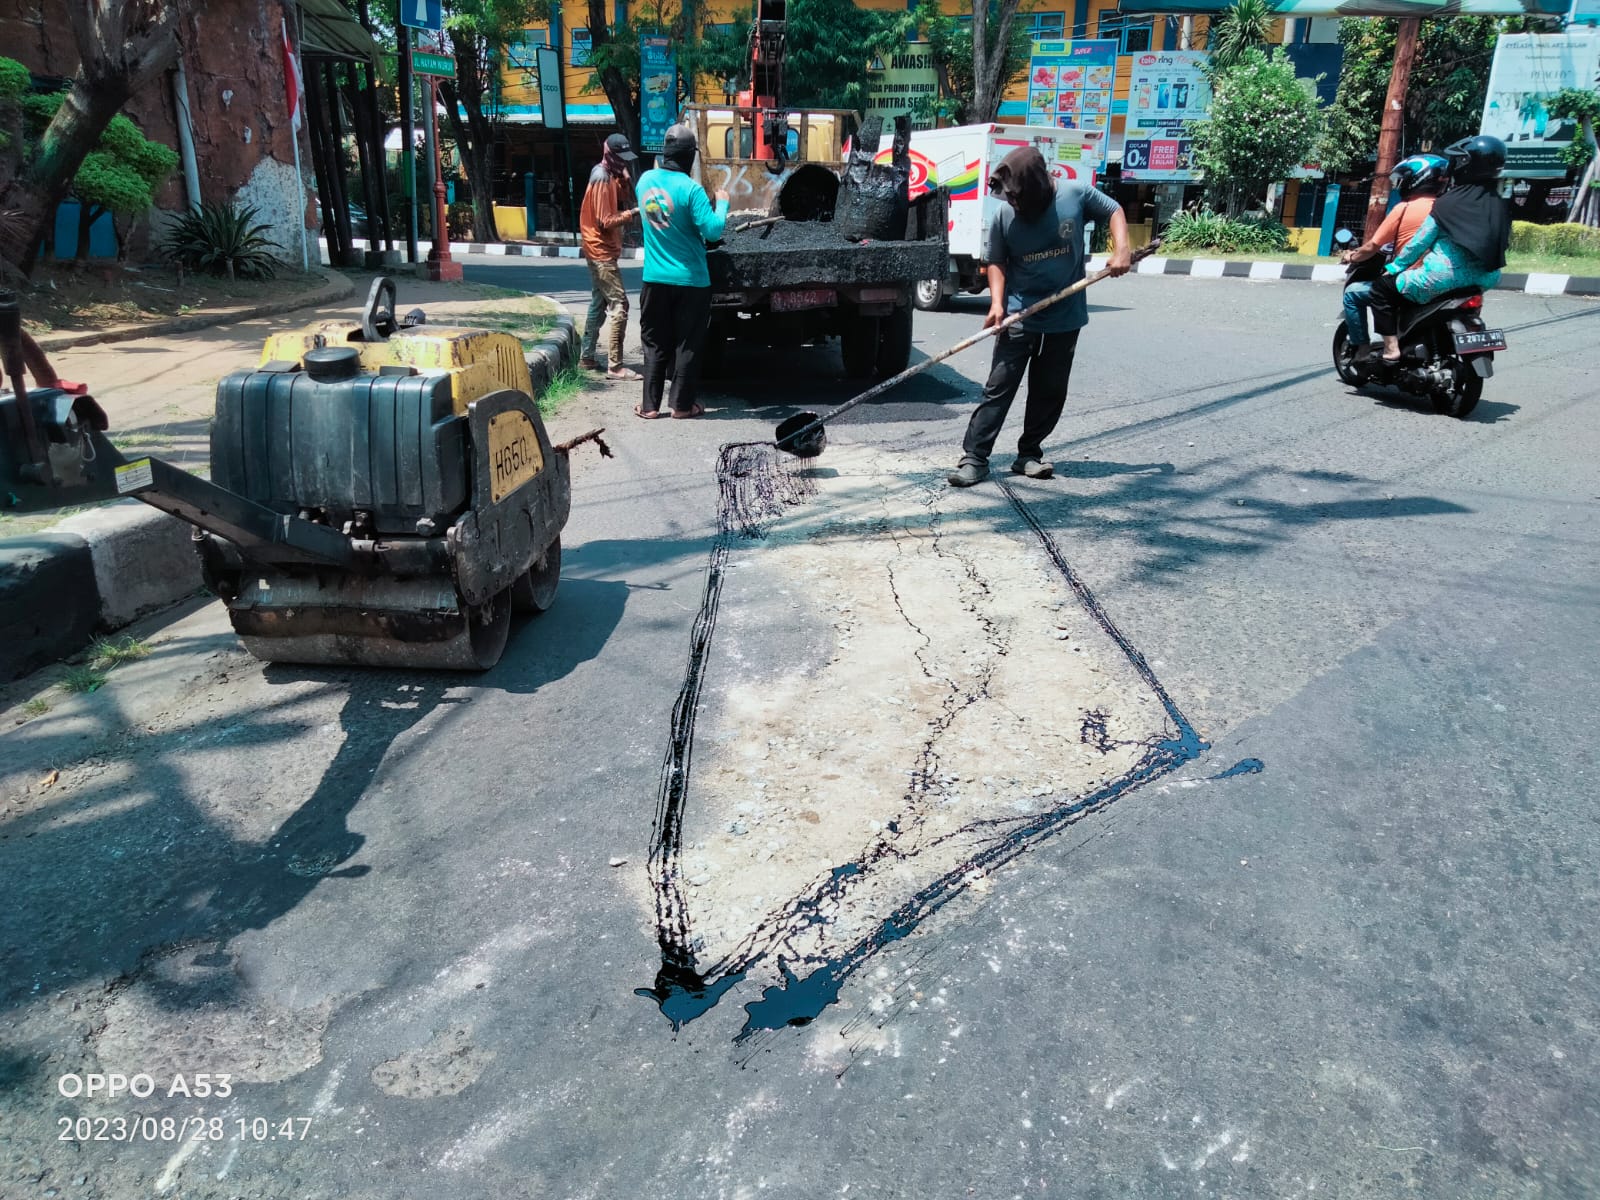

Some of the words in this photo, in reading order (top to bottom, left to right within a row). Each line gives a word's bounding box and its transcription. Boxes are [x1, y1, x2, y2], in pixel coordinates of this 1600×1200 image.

[1158, 55, 1173, 66] ring
[883, 84, 910, 93] PROMO
[878, 97, 906, 108] MITRA
[1153, 145, 1175, 154] FREE
[1126, 148, 1147, 167] 0%
